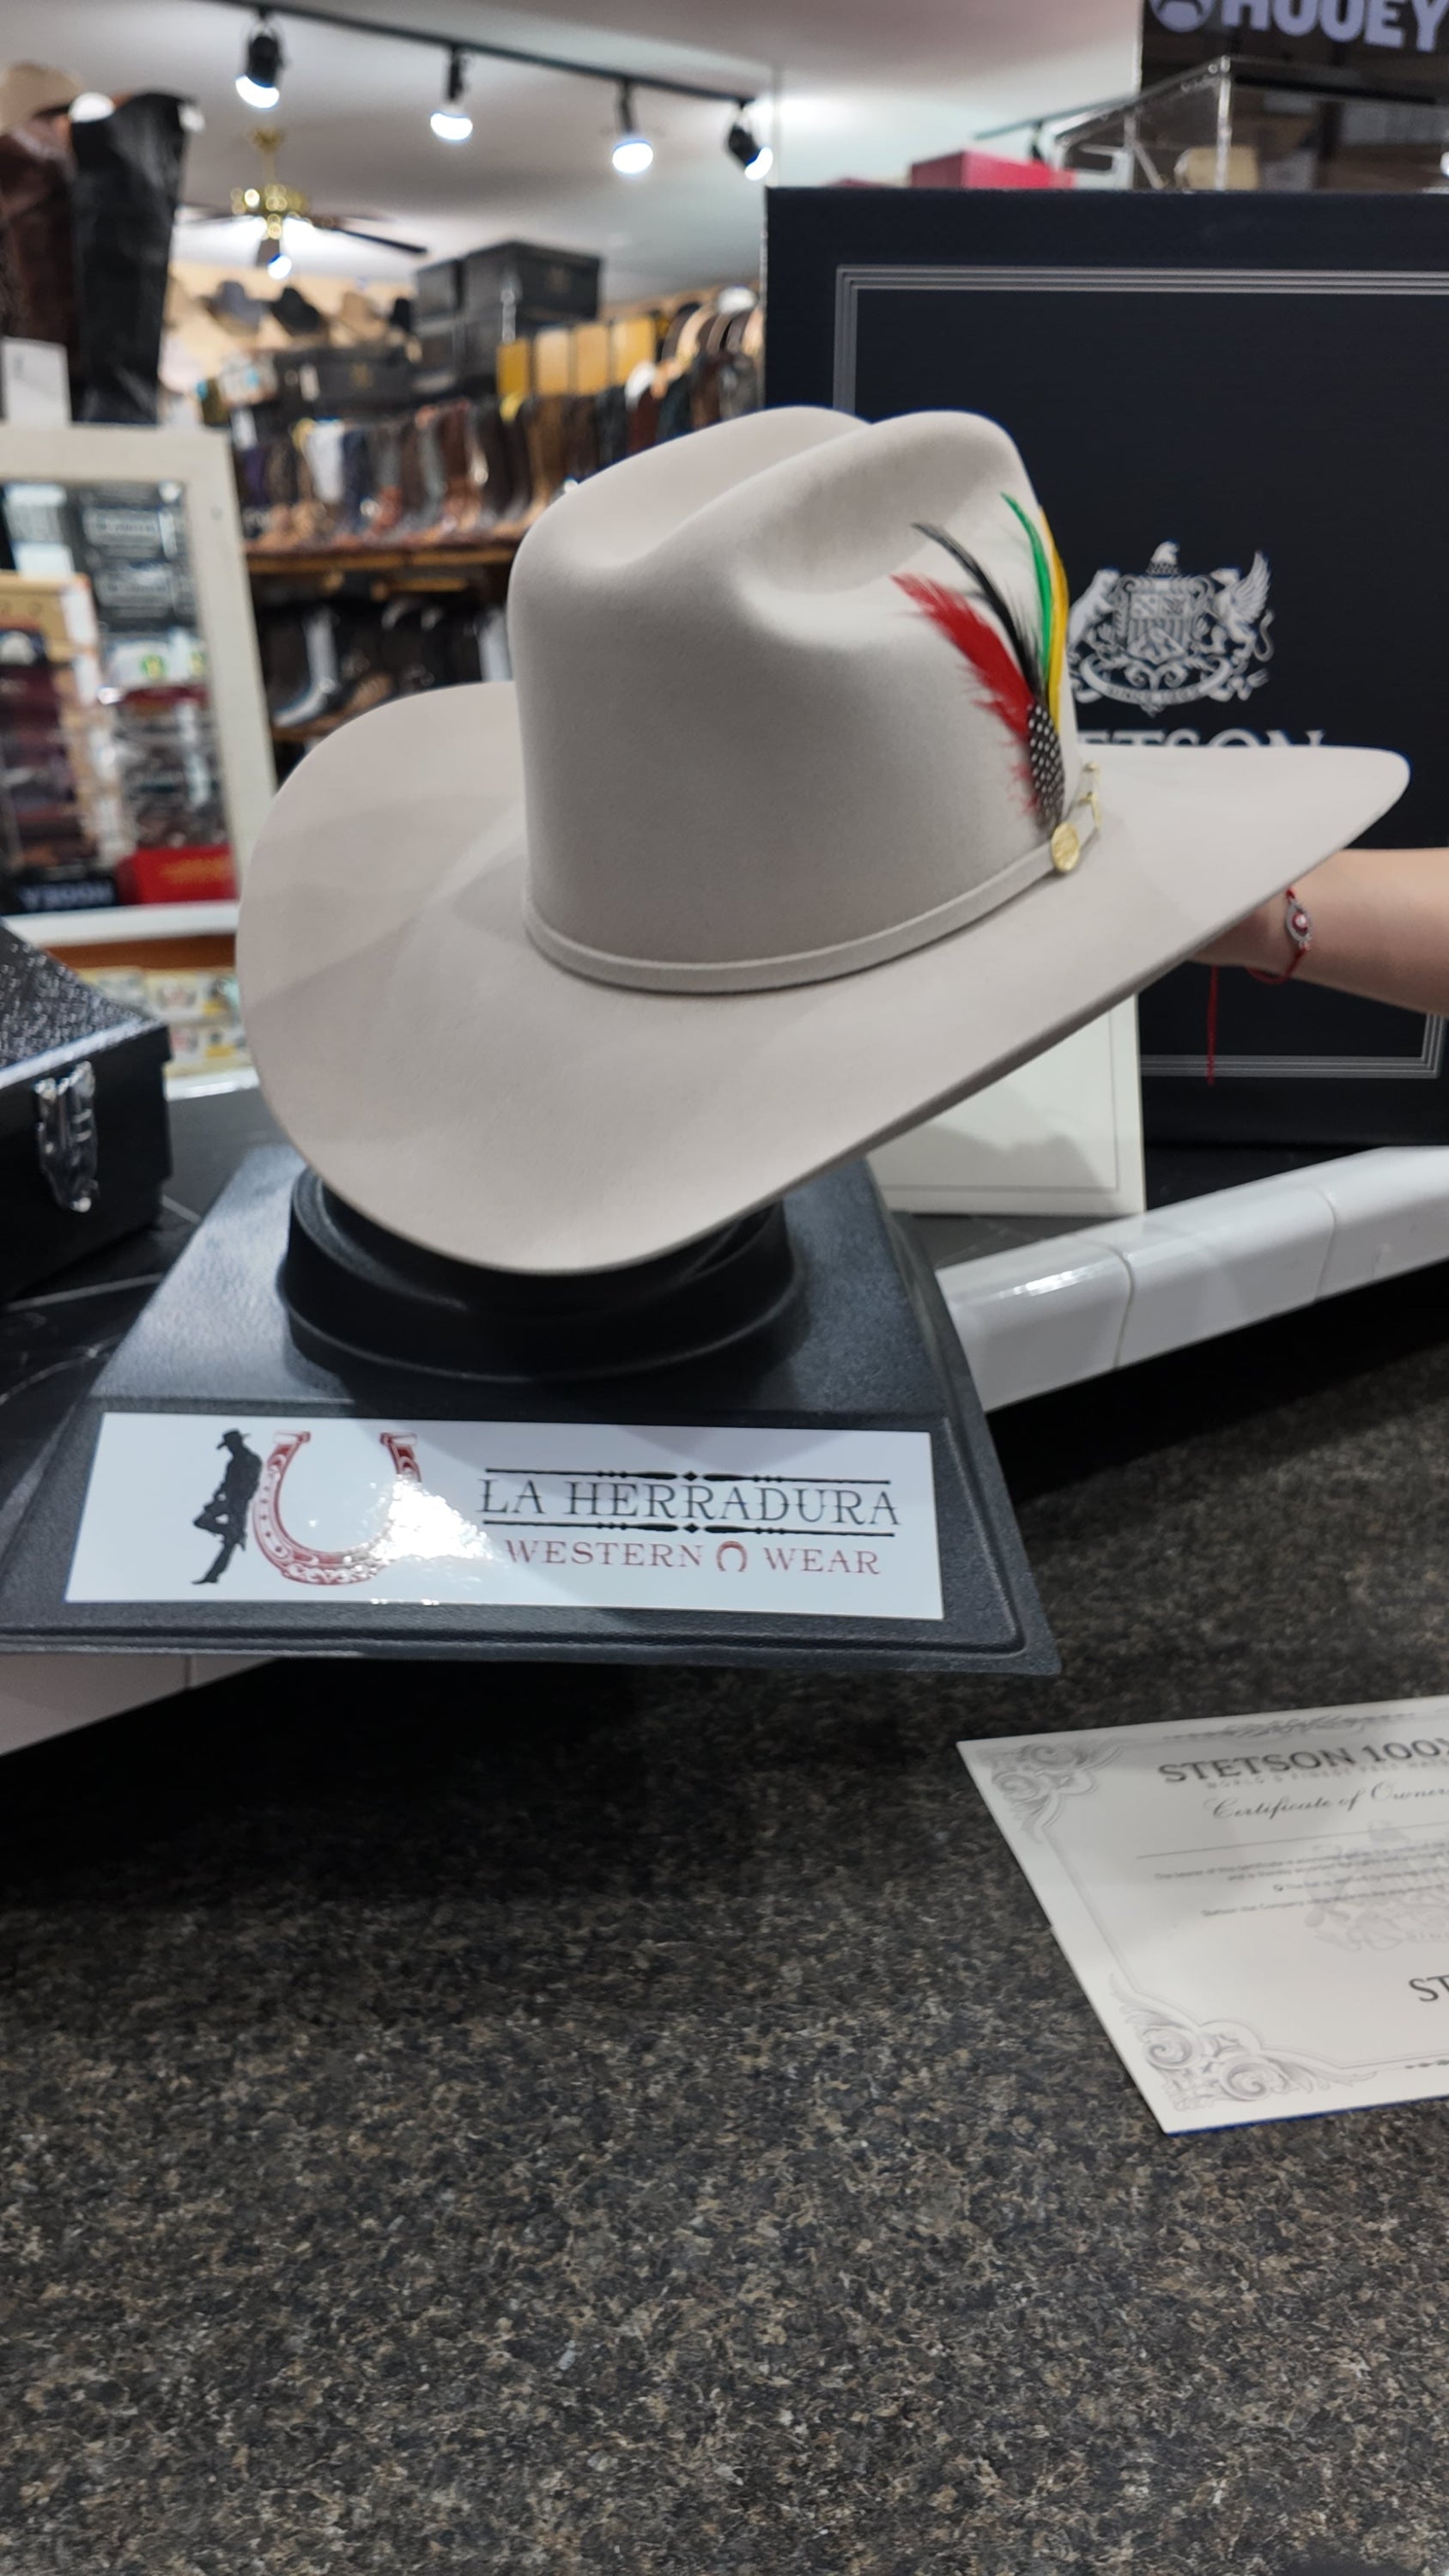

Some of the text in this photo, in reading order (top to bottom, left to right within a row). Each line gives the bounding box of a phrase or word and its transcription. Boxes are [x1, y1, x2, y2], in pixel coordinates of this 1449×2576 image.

[476, 1479, 901, 1526] LA HERRADURA
[505, 1539, 881, 1575] WESTERN WEAR
[1158, 1747, 1357, 1783] STETSON
